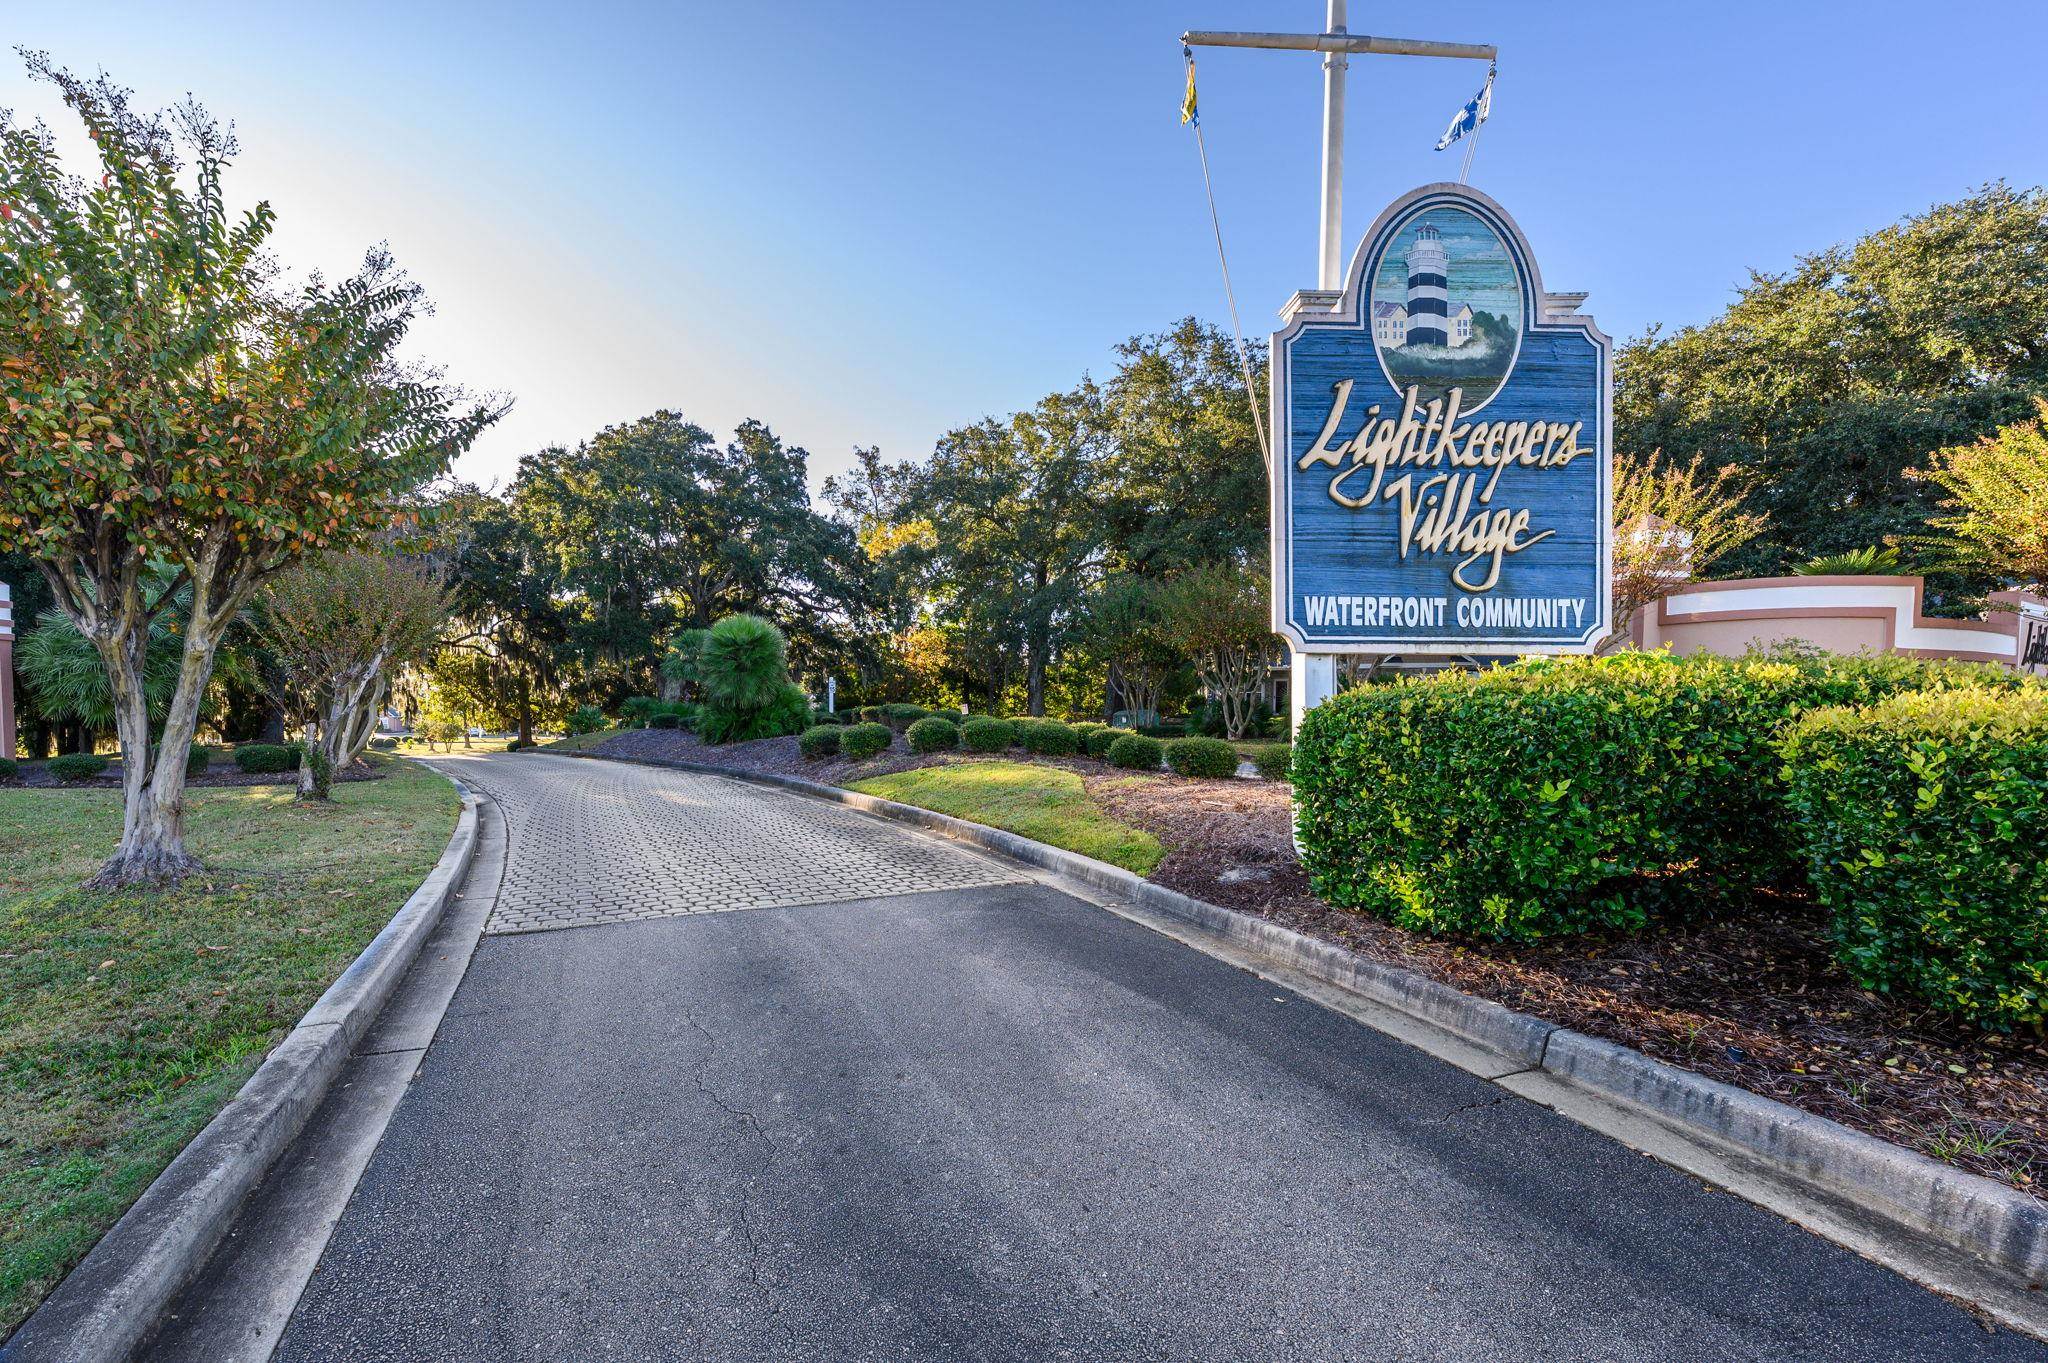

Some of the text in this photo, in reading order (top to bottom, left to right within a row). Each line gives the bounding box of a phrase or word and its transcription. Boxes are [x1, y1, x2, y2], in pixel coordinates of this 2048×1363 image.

[1298, 378, 1594, 508] Lightkeepers
[1383, 472, 1557, 592] Village
[1303, 595, 1587, 629] WATERFRONT COMMUNITY
